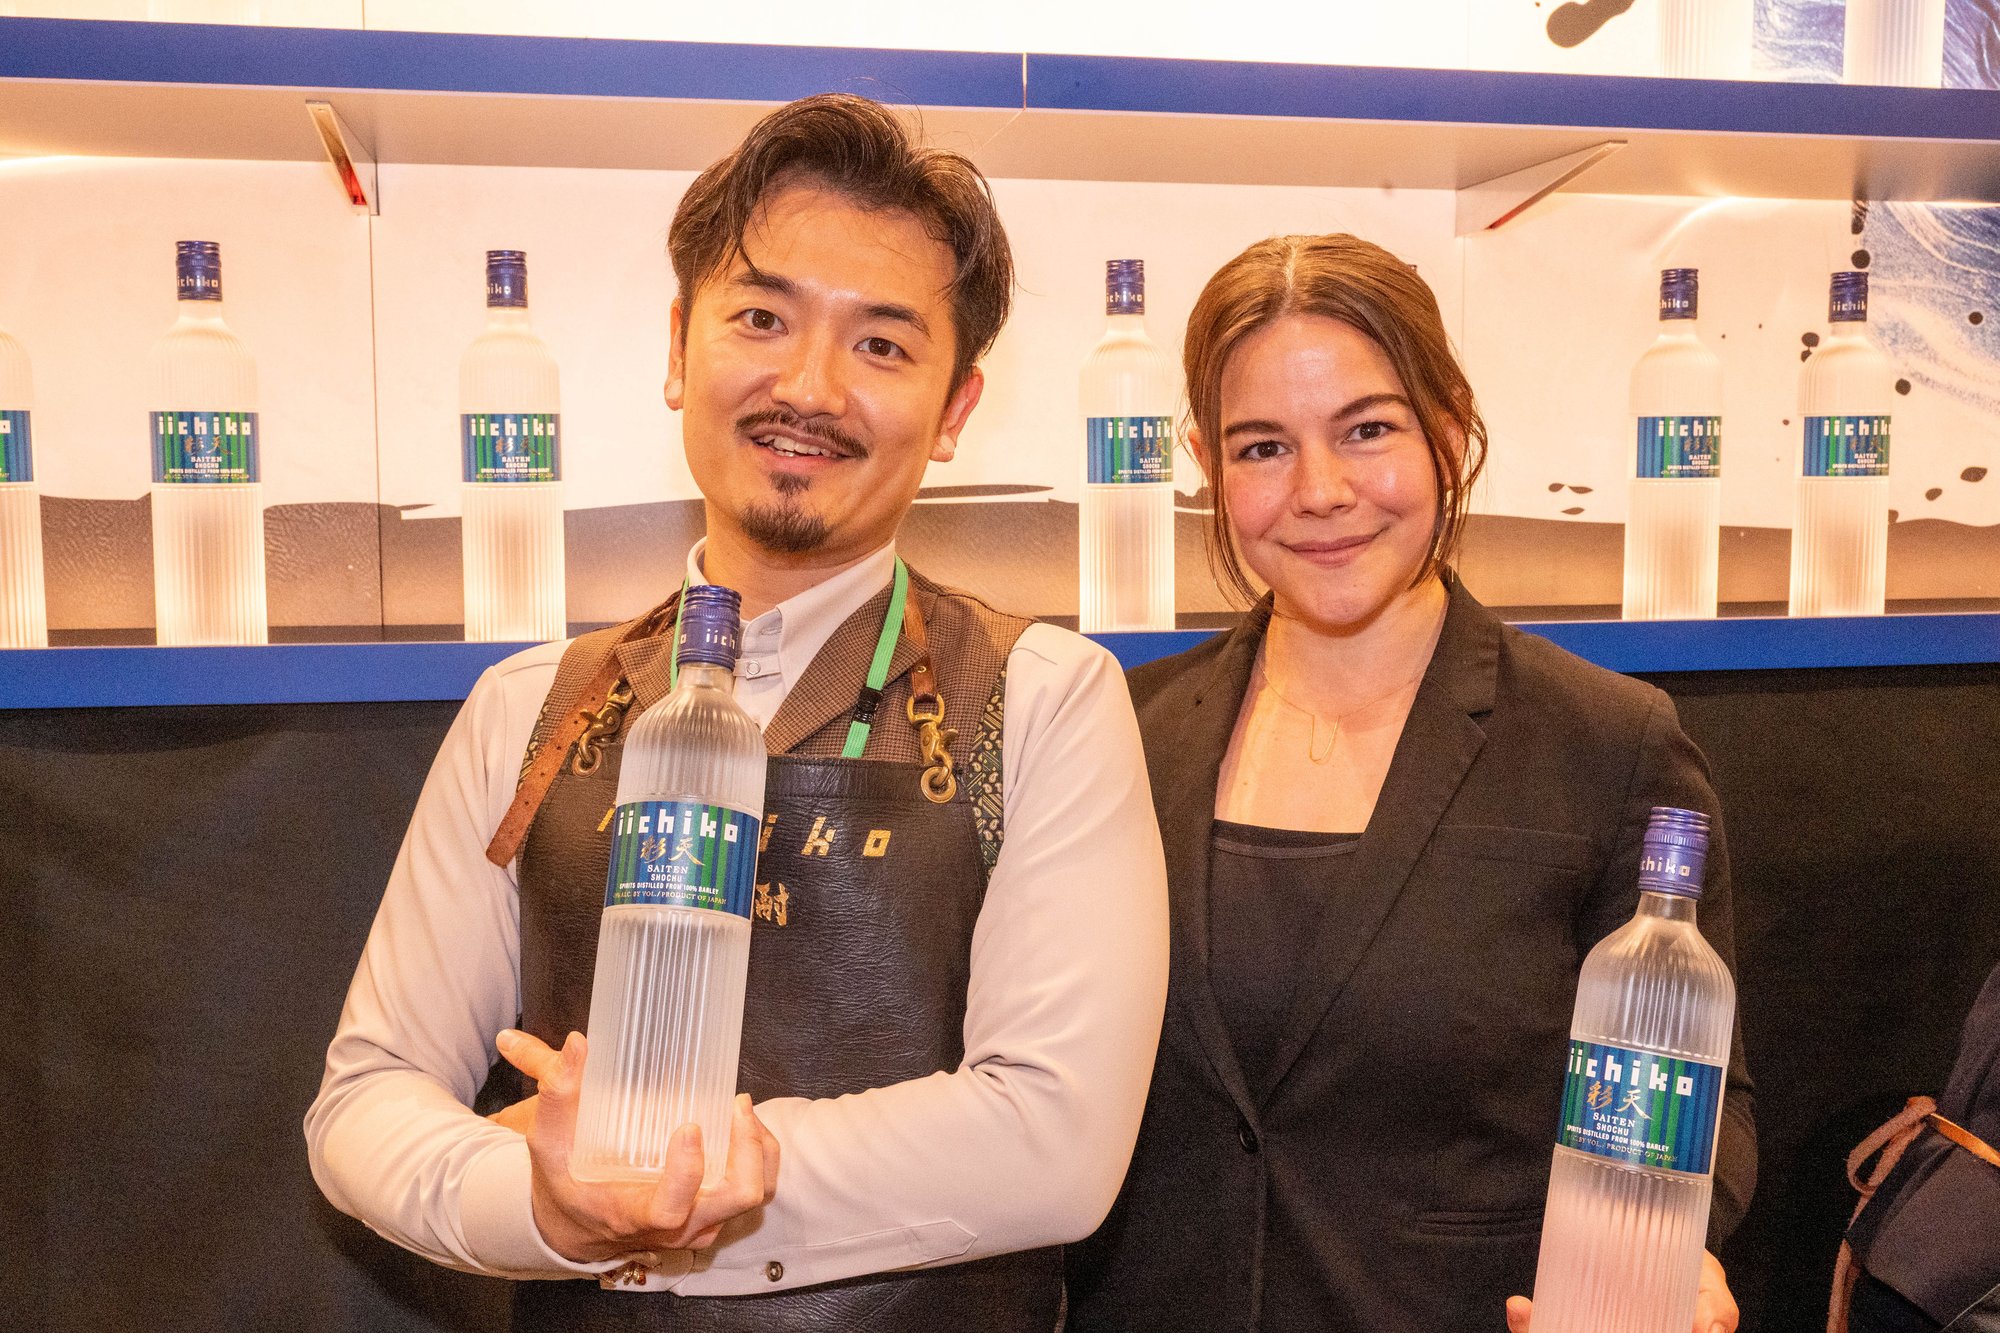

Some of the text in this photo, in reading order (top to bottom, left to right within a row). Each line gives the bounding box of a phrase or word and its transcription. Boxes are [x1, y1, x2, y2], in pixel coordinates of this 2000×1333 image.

[159, 416, 251, 435] iichiko
[471, 418, 555, 436] iichiko
[617, 808, 739, 843] iichiko
[647, 864, 689, 874] SAITEN
[650, 873, 683, 883] SHOCHU
[619, 882, 636, 890] SPIRITS
[665, 882, 682, 891] FROM
[698, 886, 720, 895] BARLEY
[1568, 1047, 1694, 1097] iichiko
[1592, 1111, 1637, 1128] SAITEN
[1596, 1122, 1630, 1137] SHOCHU
[1566, 1124, 1582, 1134] SPIRITS
[1582, 1128, 1610, 1140] DISTILLED
[1611, 1134, 1629, 1145] FROM
[1646, 1142, 1670, 1153] BARLEY
